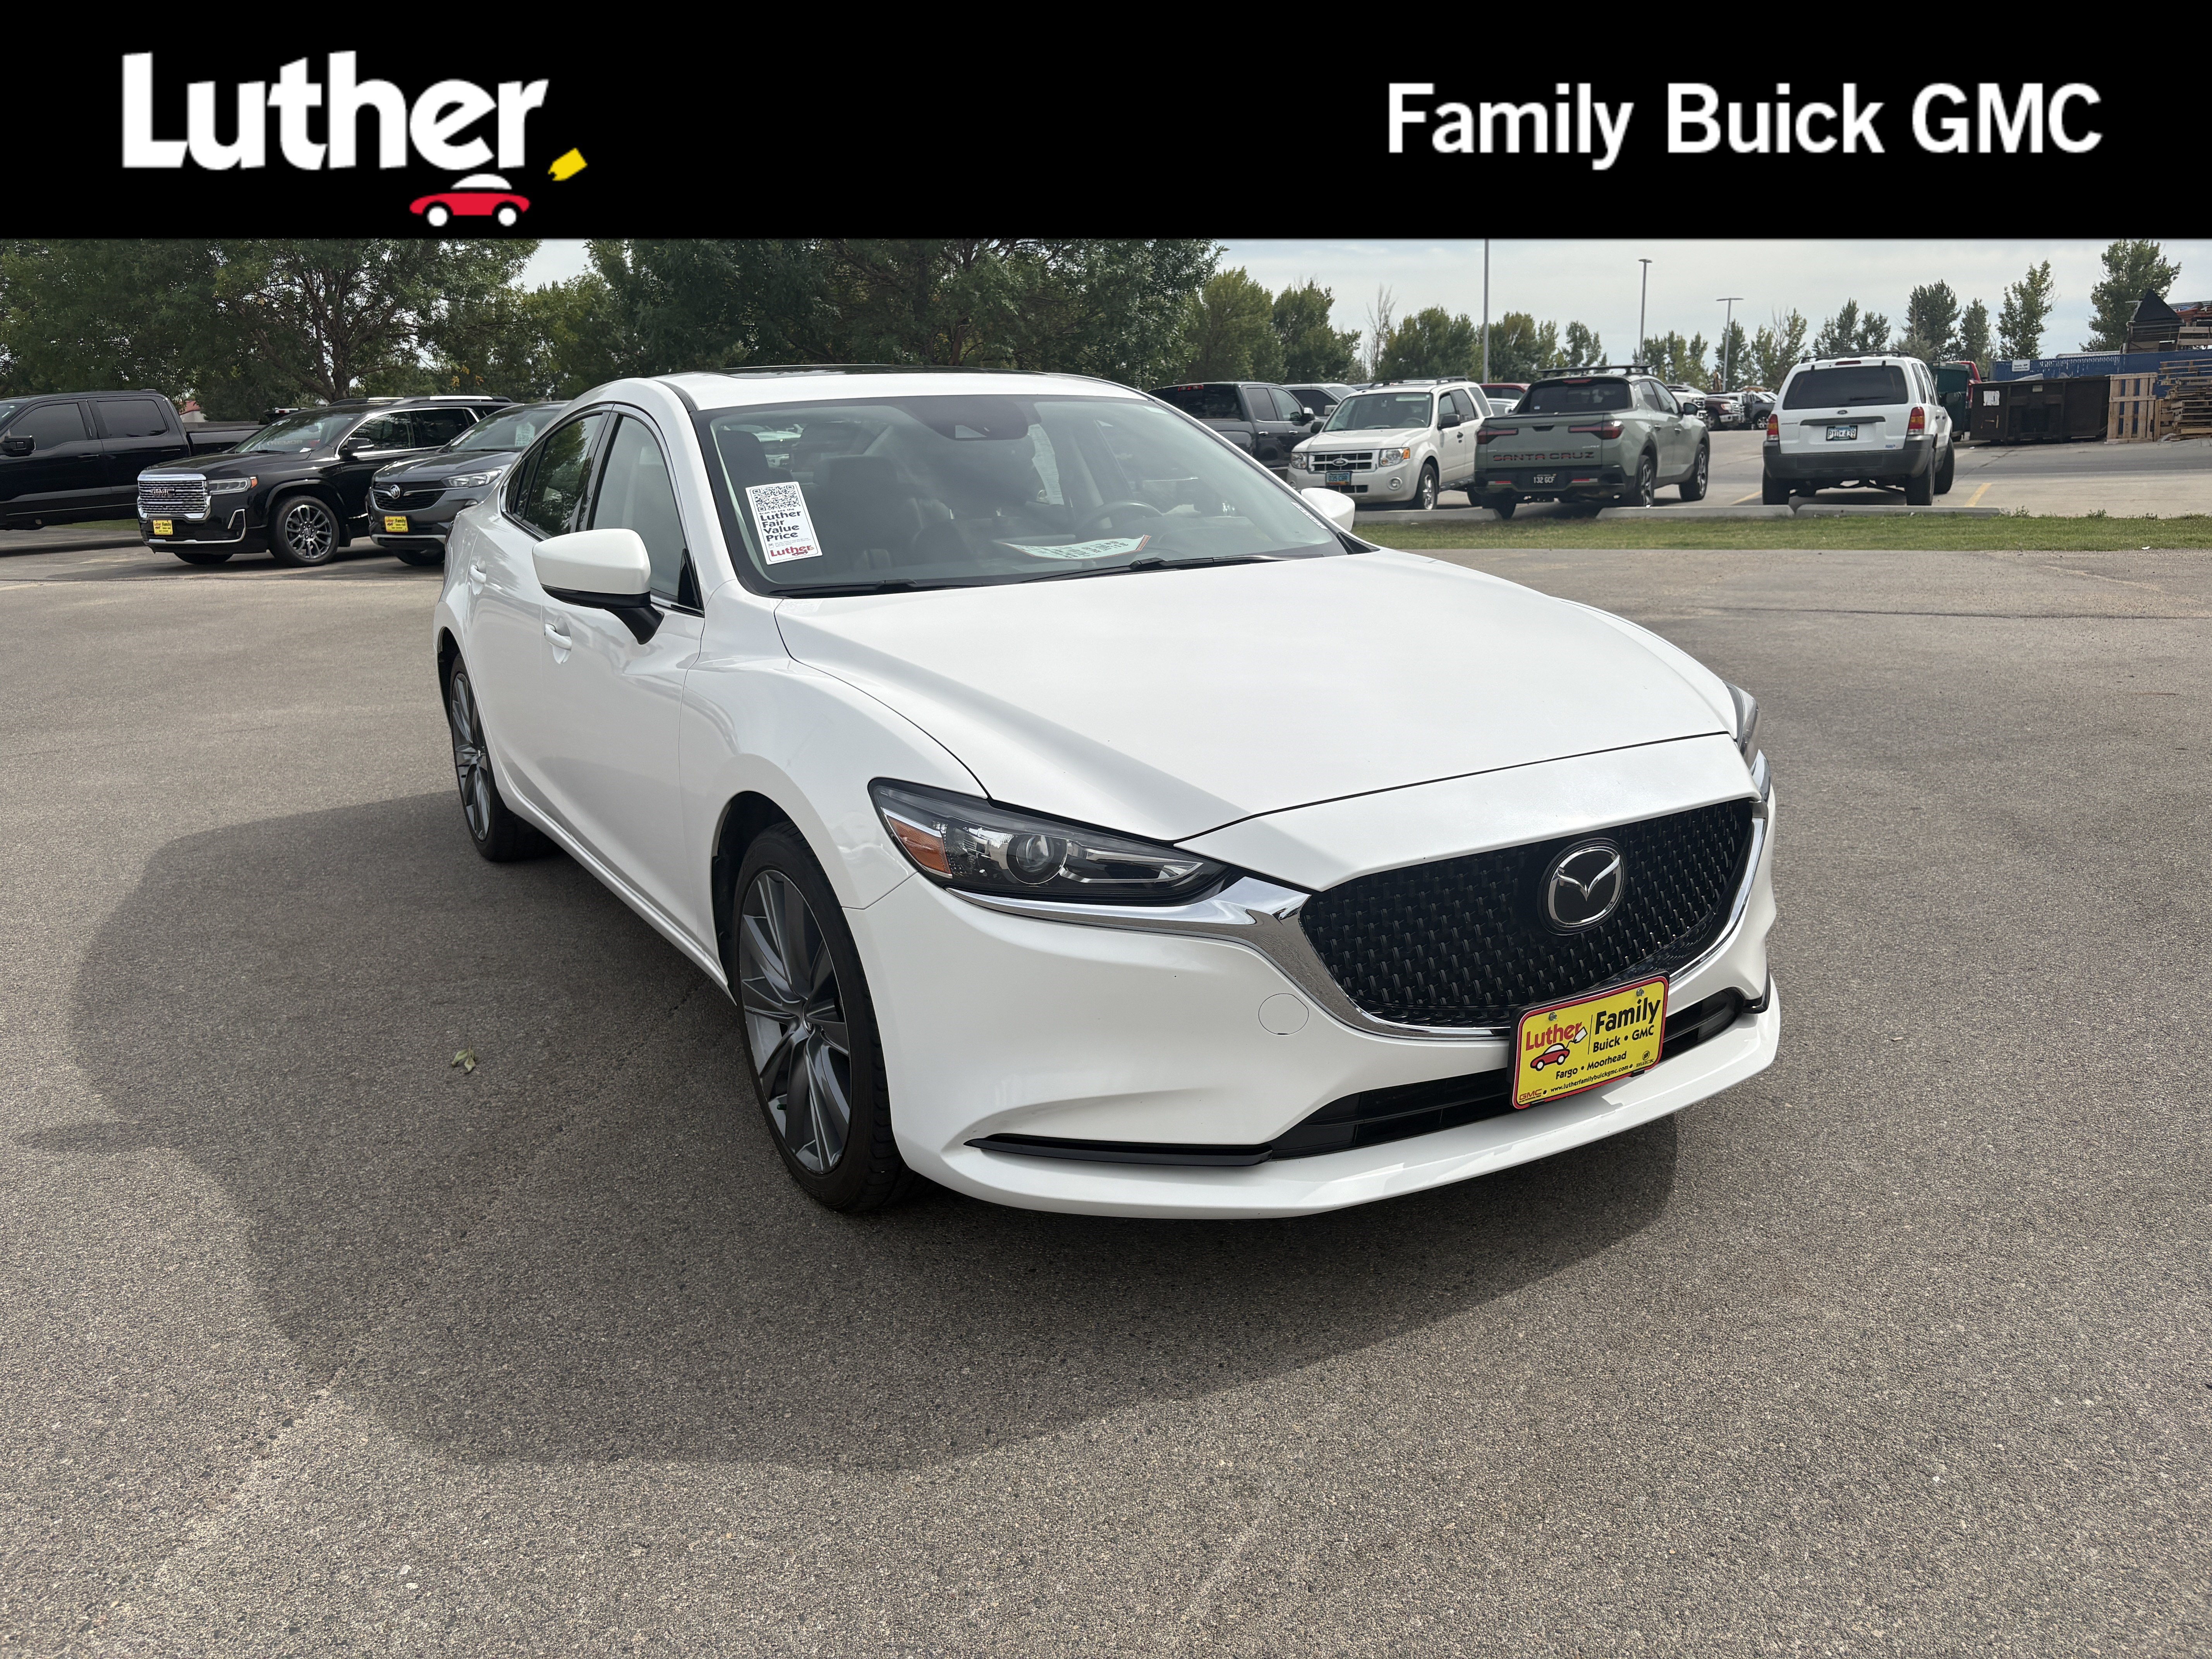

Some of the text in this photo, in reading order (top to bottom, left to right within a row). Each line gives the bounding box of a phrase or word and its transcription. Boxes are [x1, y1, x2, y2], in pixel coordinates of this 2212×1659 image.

[1493, 452, 1594, 461] SANTA CRUZ
[760, 511, 801, 521] Luther
[762, 519, 785, 528] Fair
[763, 525, 800, 534] Value
[766, 532, 798, 541] Price
[770, 545, 812, 557] Luther
[1525, 997, 1661, 1051] Luther Family
[1593, 1025, 1654, 1053] Buick GMC
[1556, 1051, 1627, 1080] Fargo Moorhead
[1550, 1065, 1629, 1093] www.lutherfamilybuickgmc.com
[1519, 1088, 1542, 1100] GMC
